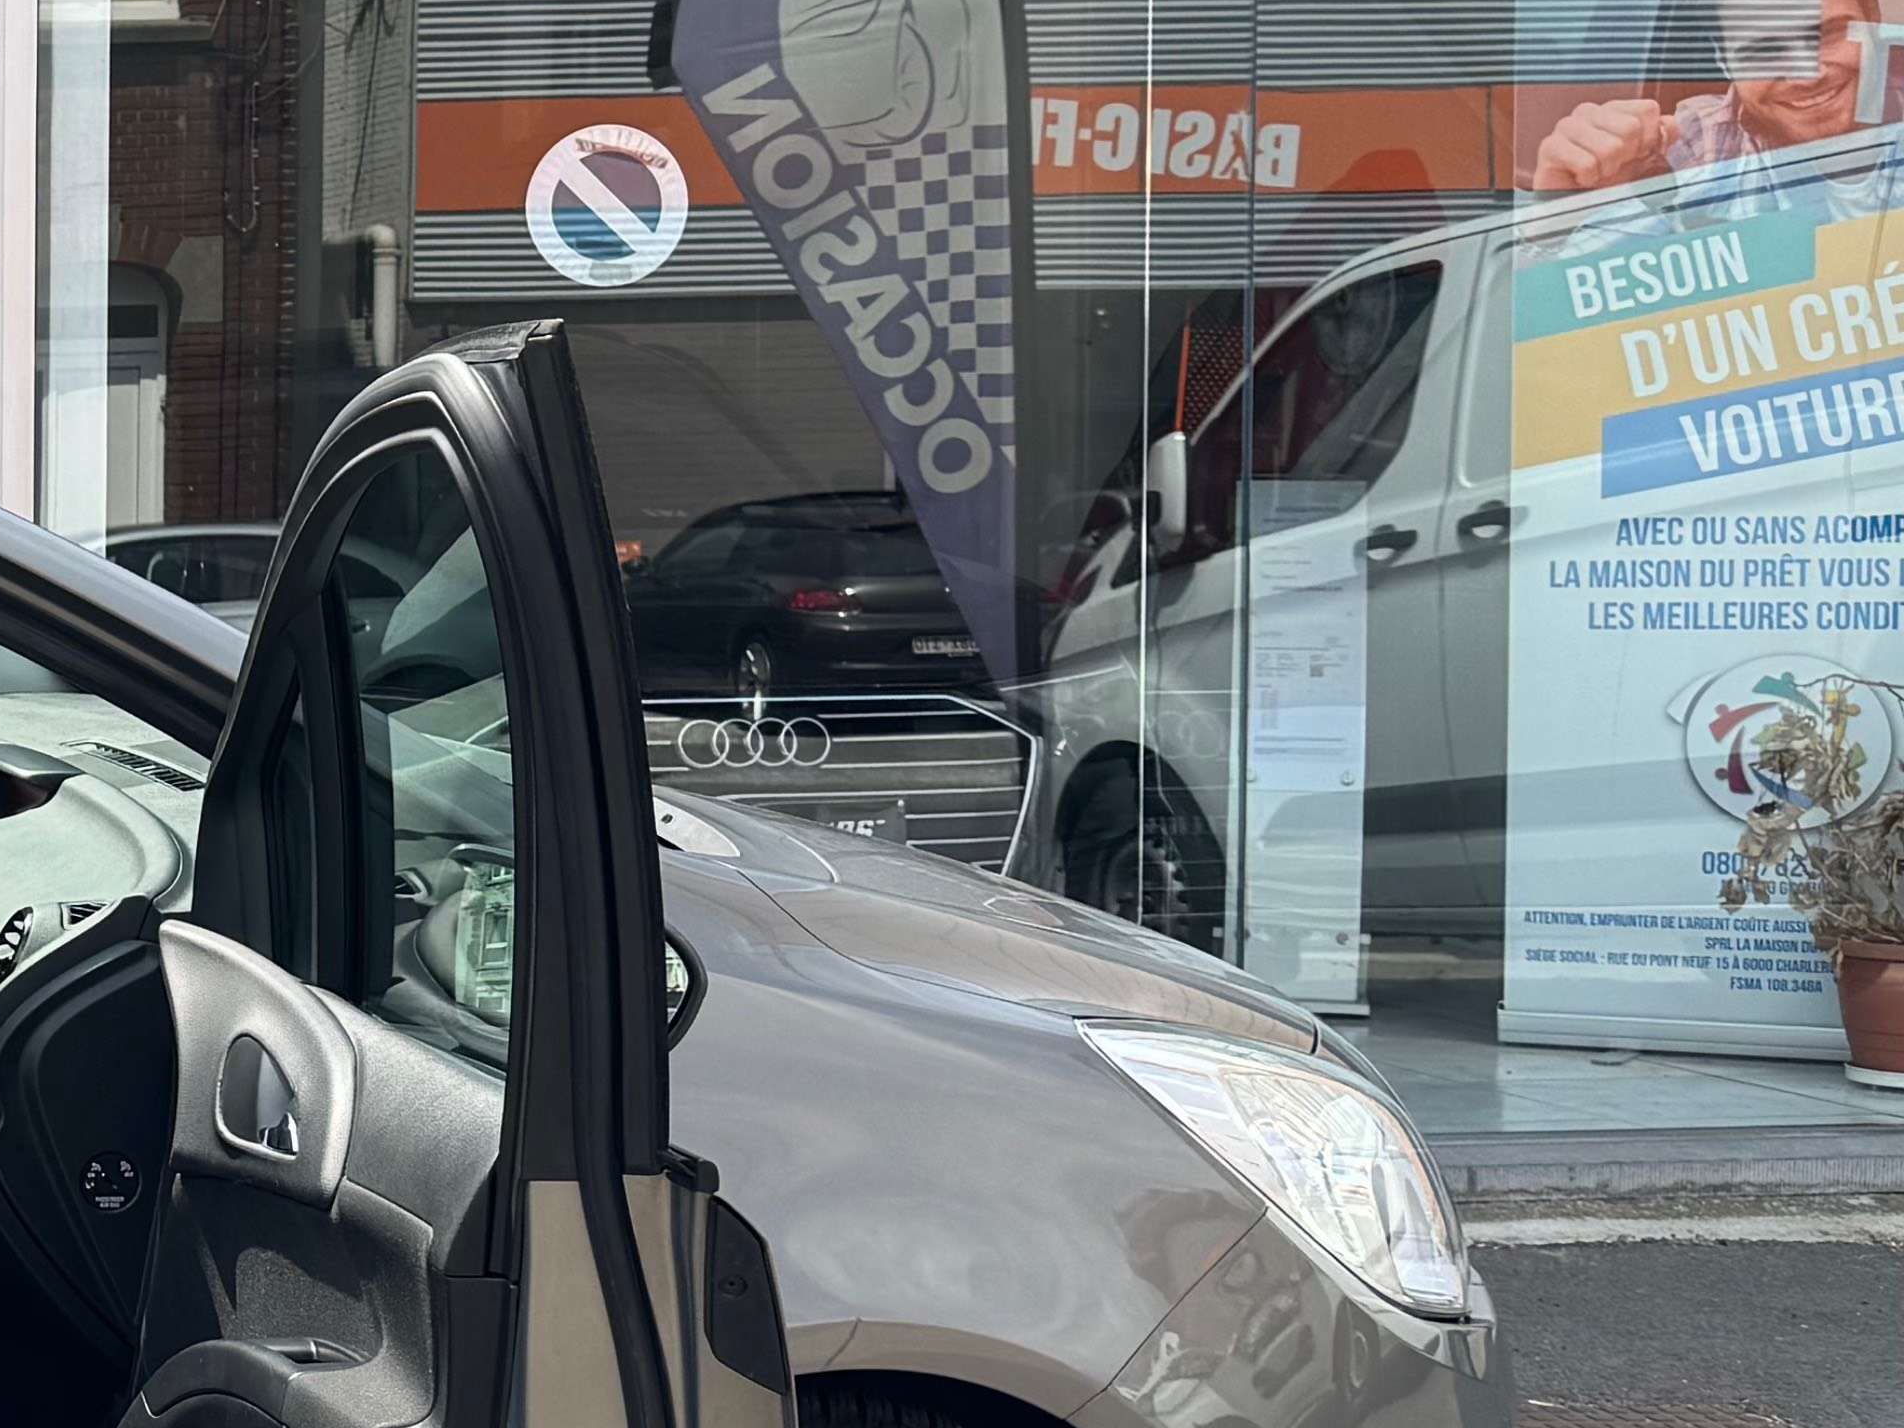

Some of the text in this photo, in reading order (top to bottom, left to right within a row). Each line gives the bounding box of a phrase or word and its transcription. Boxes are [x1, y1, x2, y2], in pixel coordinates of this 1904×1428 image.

[1565, 231, 1749, 319] BESOIN
[1616, 517, 1683, 546] AVEC
[1692, 517, 1726, 545] OU
[1735, 516, 1806, 545] SANS
[1549, 553, 1890, 589] LA MAISON DU PRÊT VOUS
[1588, 601, 1634, 630] LES
[1643, 601, 1808, 630] MEILLEURES
[1524, 910, 1586, 926] ATTENTION,
[1590, 913, 1659, 929] EMPRUNTER
[1661, 916, 1675, 929] DE
[1733, 916, 1772, 933] COÛTE
[1773, 920, 1806, 933] AUSSI
[1705, 937, 1733, 950] SPRL
[1737, 938, 1750, 952] LA
[1753, 938, 1798, 953] MAISON
[1560, 950, 1598, 964] SOCIAL
[1607, 952, 1629, 965] RUE
[1632, 953, 1647, 966] DU
[1649, 954, 1679, 968] PONT
[1681, 955, 1712, 969] NEUF
[1716, 957, 1729, 970] 15
[1730, 977, 1762, 991] FSMA
